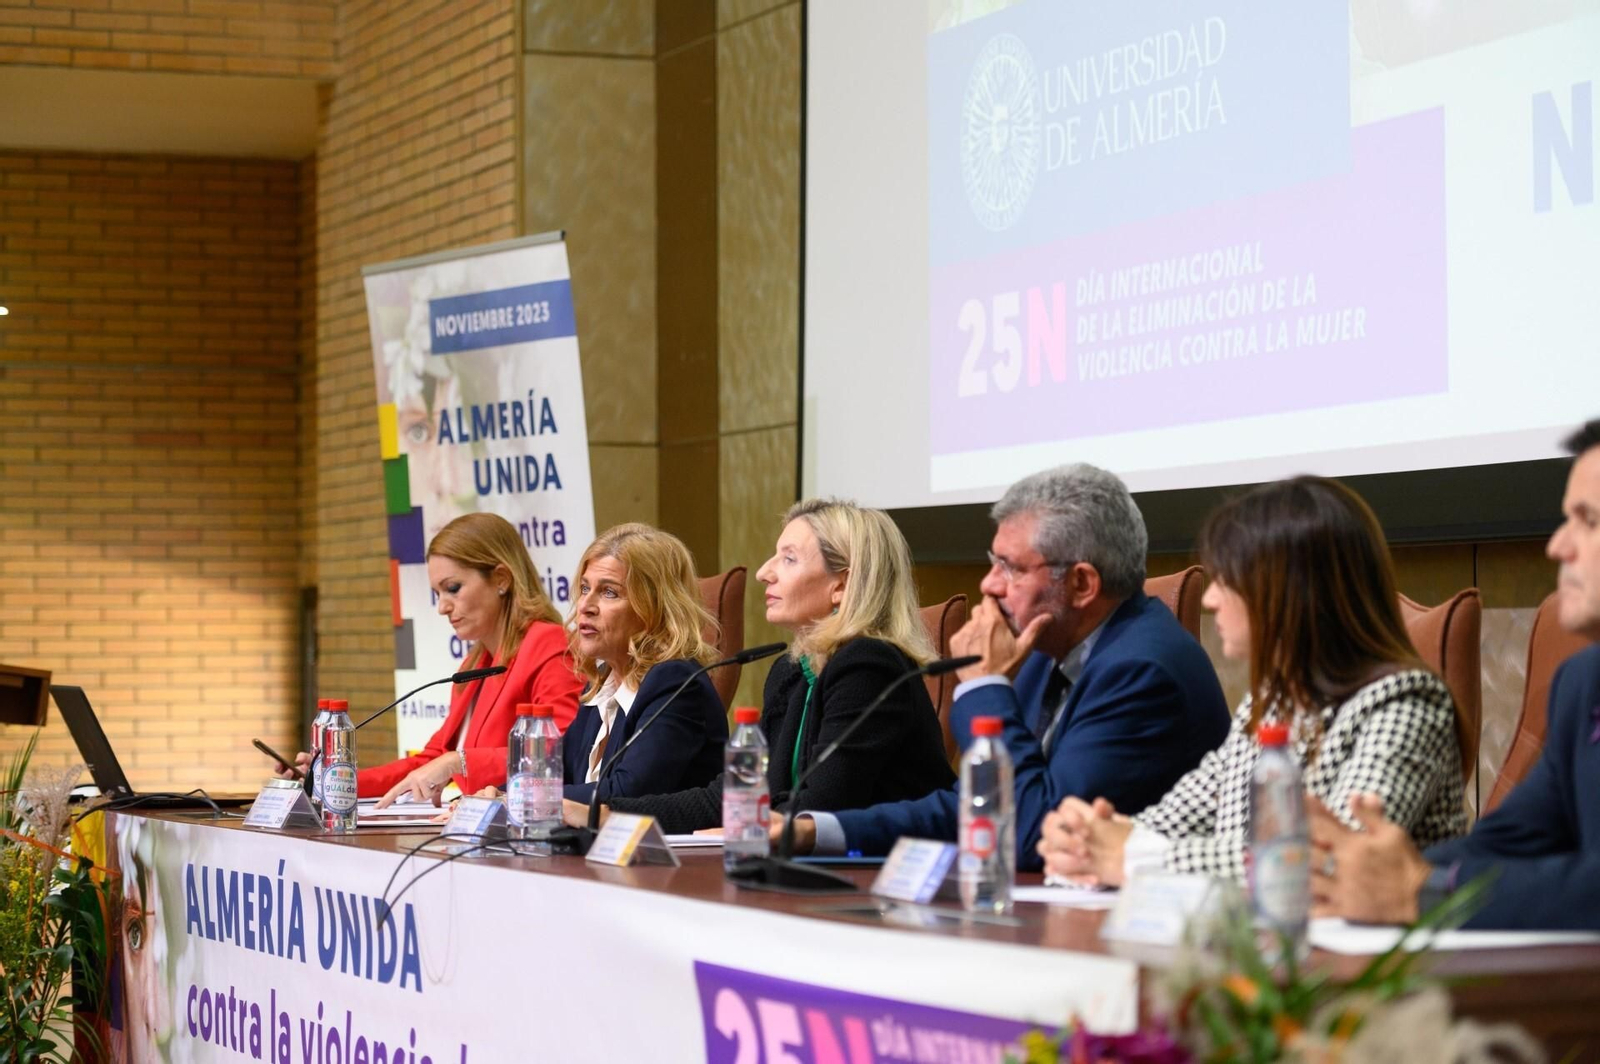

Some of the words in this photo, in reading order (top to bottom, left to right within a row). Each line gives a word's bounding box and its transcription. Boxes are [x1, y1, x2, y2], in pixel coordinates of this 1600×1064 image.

[1043, 16, 1227, 113] UNIVERSIDAD
[1045, 116, 1082, 171] DE
[1090, 70, 1228, 160] ALMERÍA
[1076, 267, 1105, 307] DÍA
[1111, 240, 1264, 299] INTERNACIONAL
[1076, 313, 1098, 345] DE
[1101, 308, 1123, 341] LA
[1128, 280, 1256, 337] ELIMINACIÓN
[1261, 277, 1287, 312] DE
[1292, 271, 1317, 307] LA
[435, 306, 514, 338] NOVIEMBRE
[516, 300, 550, 326] 2023
[957, 281, 1067, 398] 25N
[1077, 339, 1173, 382] VIOLENCIA
[1179, 325, 1259, 366] CONTRA
[1265, 320, 1289, 353] LA
[1296, 305, 1367, 347] MUJER
[438, 389, 558, 445] ALMERÍA
[473, 454, 562, 496] UNIDA
[519, 516, 566, 547] ntra
[186, 858, 306, 963] ALMERÍA
[314, 886, 424, 993] UNIDA
[187, 984, 262, 1060] contra
[270, 988, 291, 1064] la
